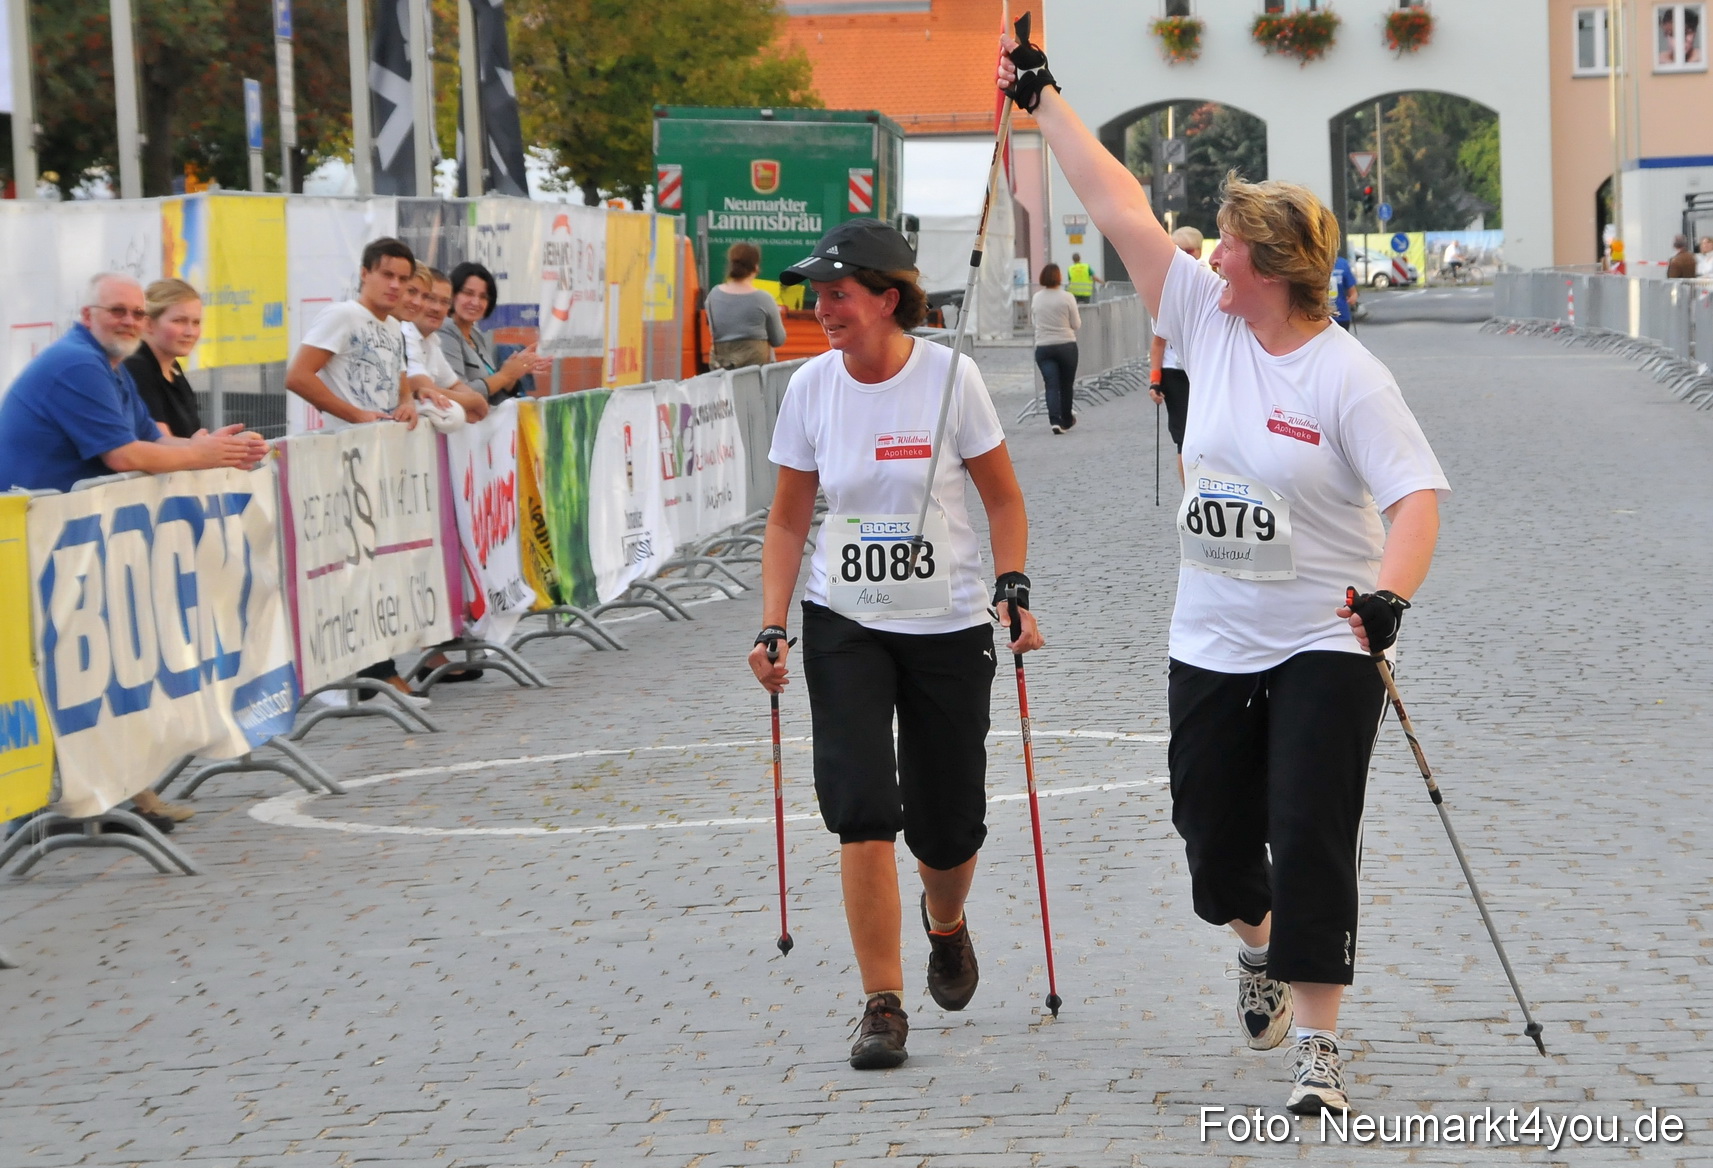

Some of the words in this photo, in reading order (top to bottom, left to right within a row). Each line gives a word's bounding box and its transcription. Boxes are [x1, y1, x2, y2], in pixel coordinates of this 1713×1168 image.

[724, 197, 808, 212] Neumarkter
[708, 210, 822, 232] Lammsbräu
[897, 436, 929, 444] Wildbad
[1274, 422, 1313, 440] Apotheke
[884, 448, 923, 458] Apotheke
[1199, 478, 1250, 496] BOCK
[860, 522, 911, 534] BOCK
[1186, 496, 1276, 542] 8079
[1202, 543, 1253, 561] Waltraud
[841, 541, 936, 583] 8083
[39, 493, 252, 737] BOCK
